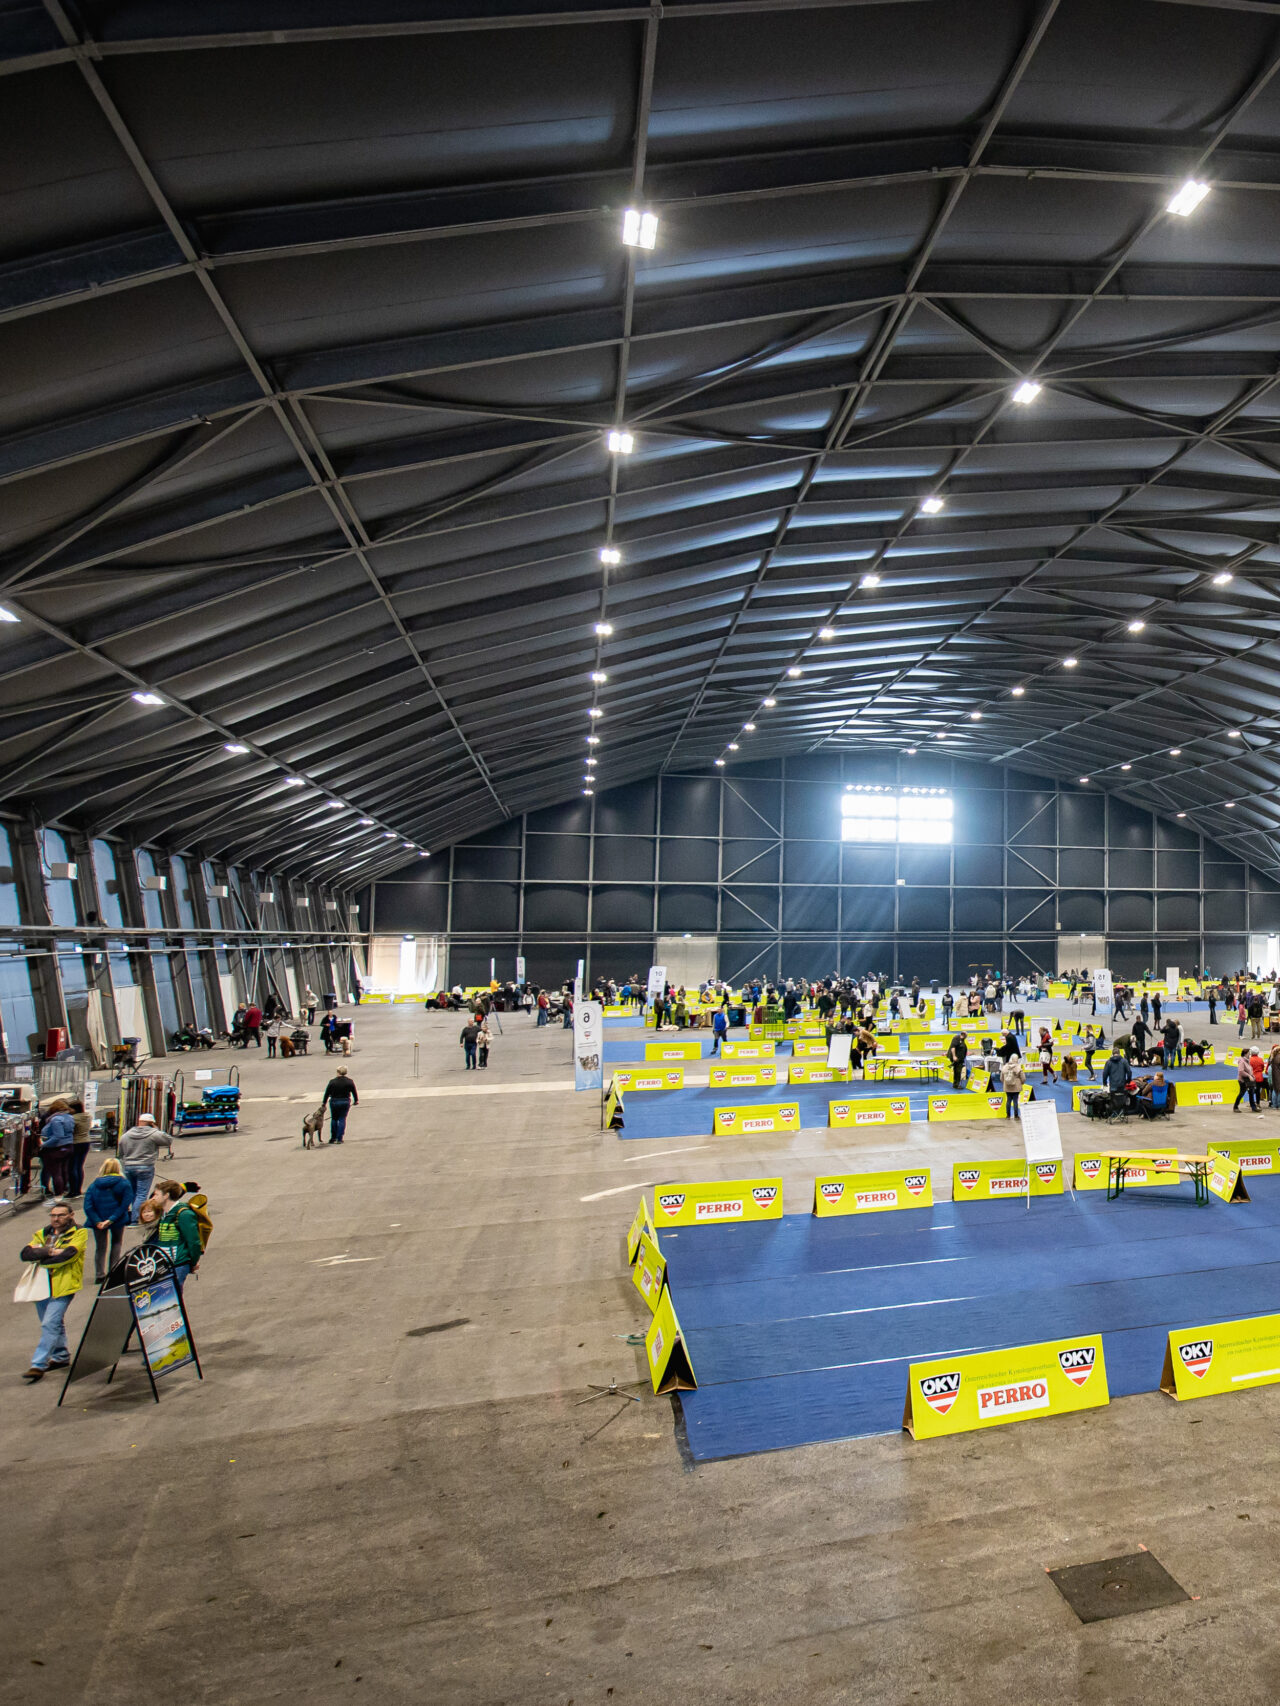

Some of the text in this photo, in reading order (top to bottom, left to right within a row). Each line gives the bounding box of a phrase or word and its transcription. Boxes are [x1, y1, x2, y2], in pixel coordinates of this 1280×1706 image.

[857, 1112, 885, 1120] PERRO
[744, 1120, 773, 1128] PERRO
[1240, 1157, 1271, 1168] PERRO
[991, 1179, 1028, 1189] PERRO
[856, 1192, 896, 1203] PERRO
[698, 1203, 741, 1214] PERRO
[981, 1383, 1046, 1409] PERRO
